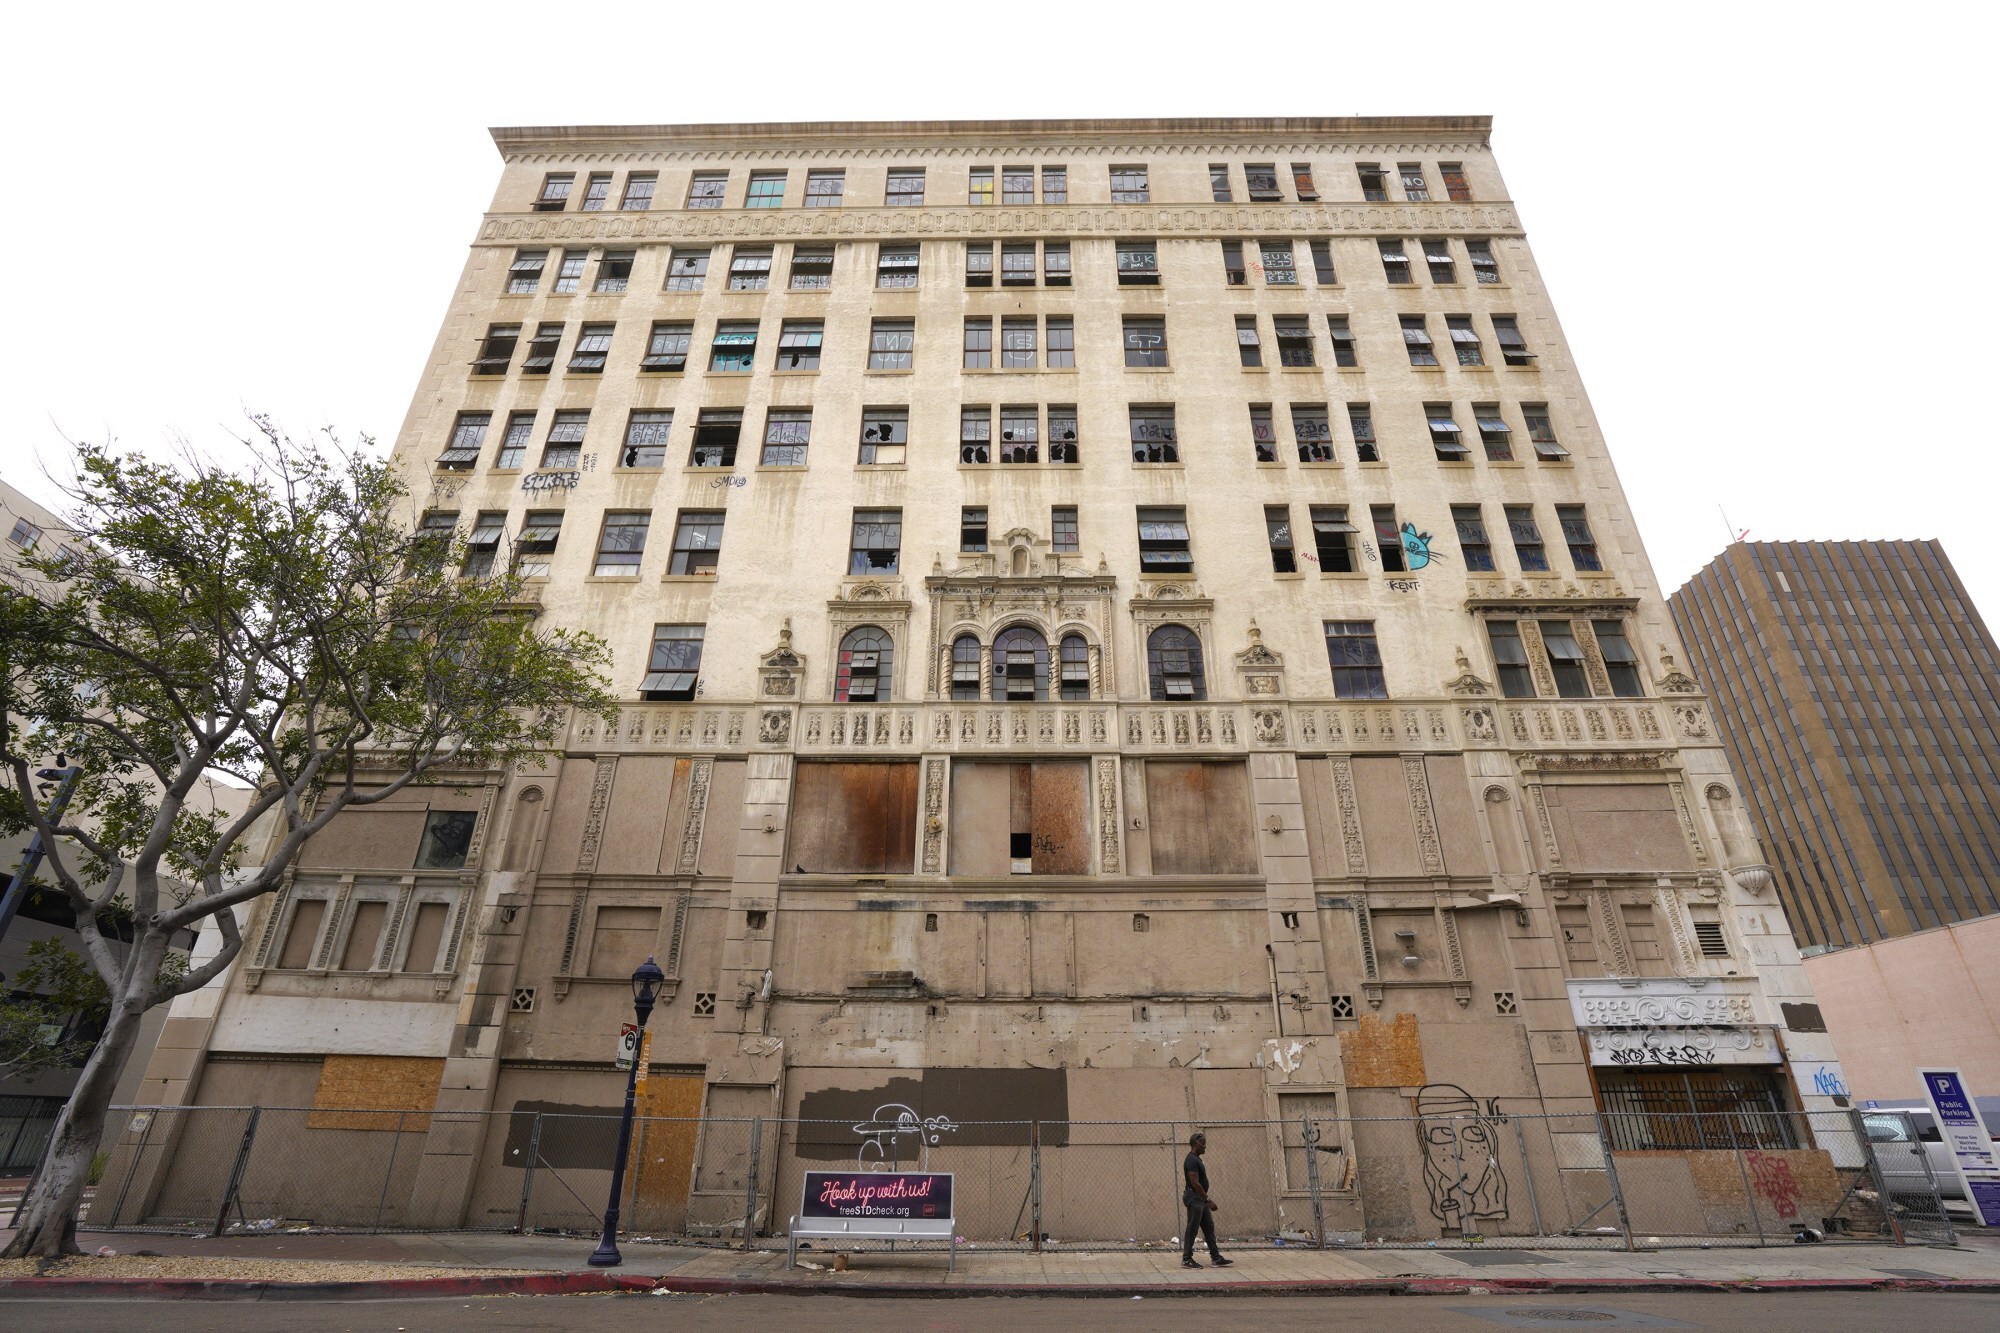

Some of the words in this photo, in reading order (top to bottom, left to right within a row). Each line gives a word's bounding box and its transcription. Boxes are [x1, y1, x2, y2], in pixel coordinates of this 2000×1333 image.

[1389, 581, 1420, 593] KENT
[640, 1044, 650, 1081] CENTER
[1941, 1110, 1971, 1118] Parking
[820, 1180, 857, 1207] Hook
[858, 1186, 876, 1208] up
[877, 1178, 907, 1198] with
[908, 1176, 932, 1197] us!
[839, 1205, 910, 1217] freeSTDcheck.org
